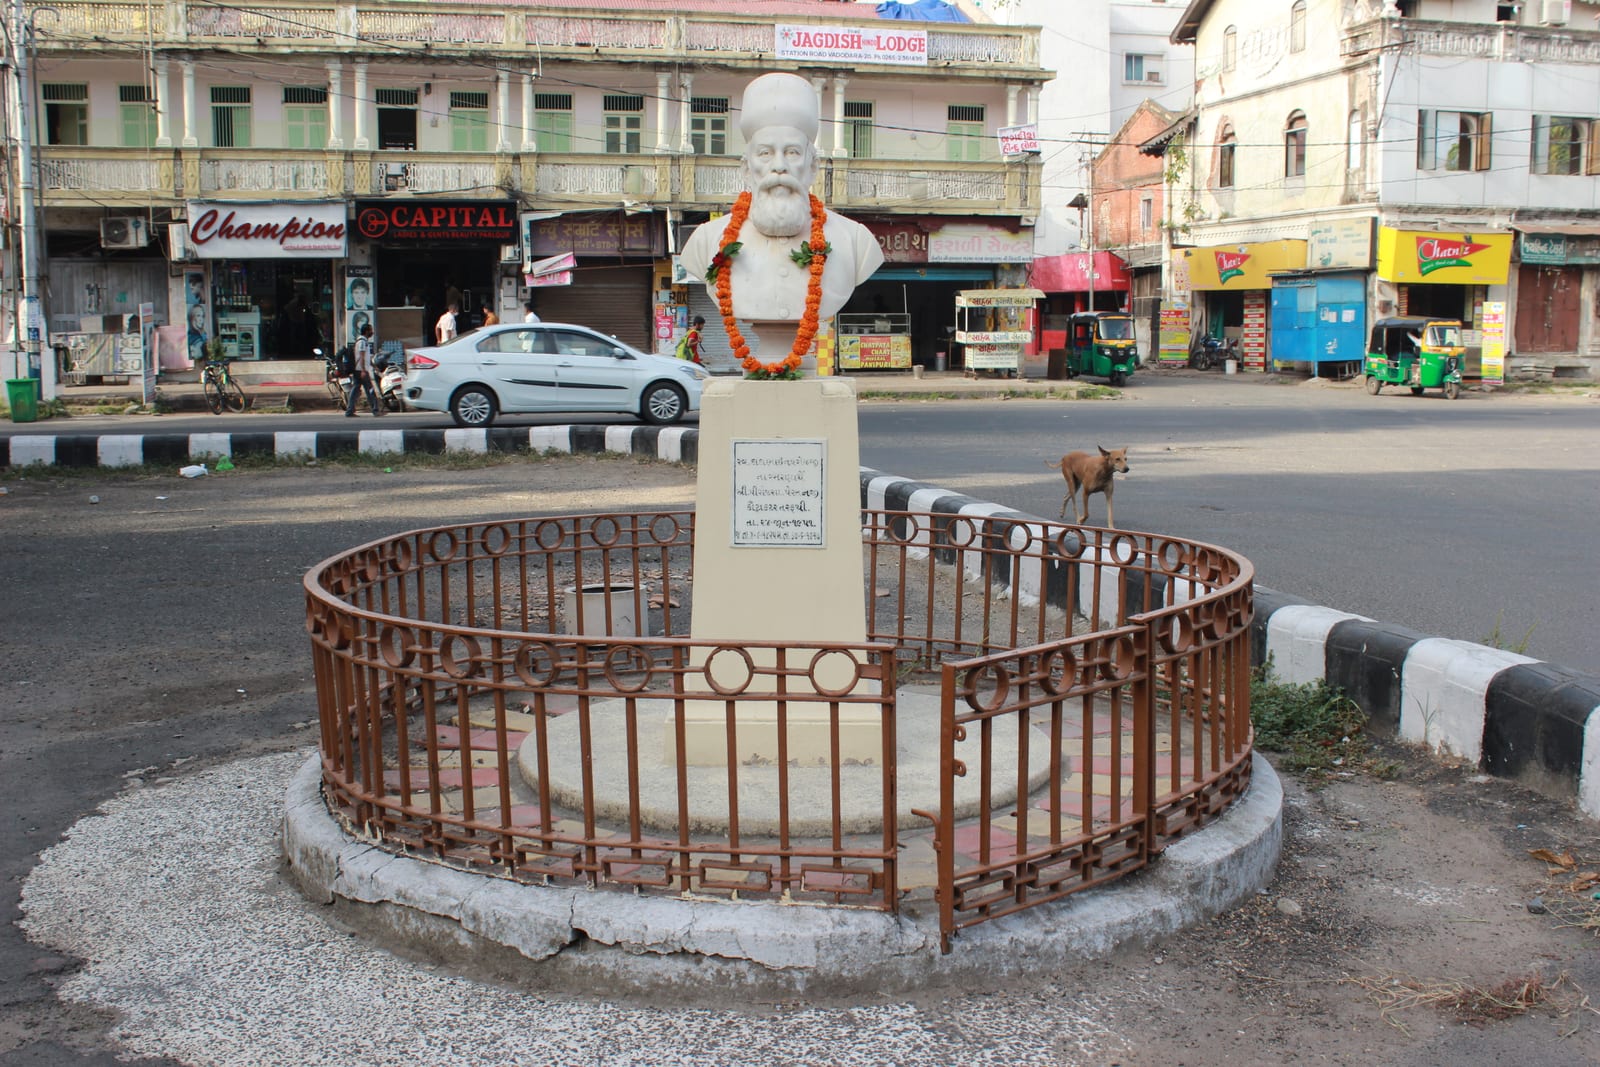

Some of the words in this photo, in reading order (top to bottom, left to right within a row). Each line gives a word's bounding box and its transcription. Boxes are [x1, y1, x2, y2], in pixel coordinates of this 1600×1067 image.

[792, 31, 862, 50] JAGDISH
[876, 35, 925, 53] LODGE
[781, 49, 809, 57] STATION
[191, 209, 345, 245] Champion
[391, 206, 513, 228] CAPITAL
[393, 231, 417, 239] LADIES
[427, 231, 450, 239] GENTS
[451, 231, 478, 239] BEAUTY
[479, 231, 511, 239] PARLOUR
[879, 231, 927, 251] ગદીશ
